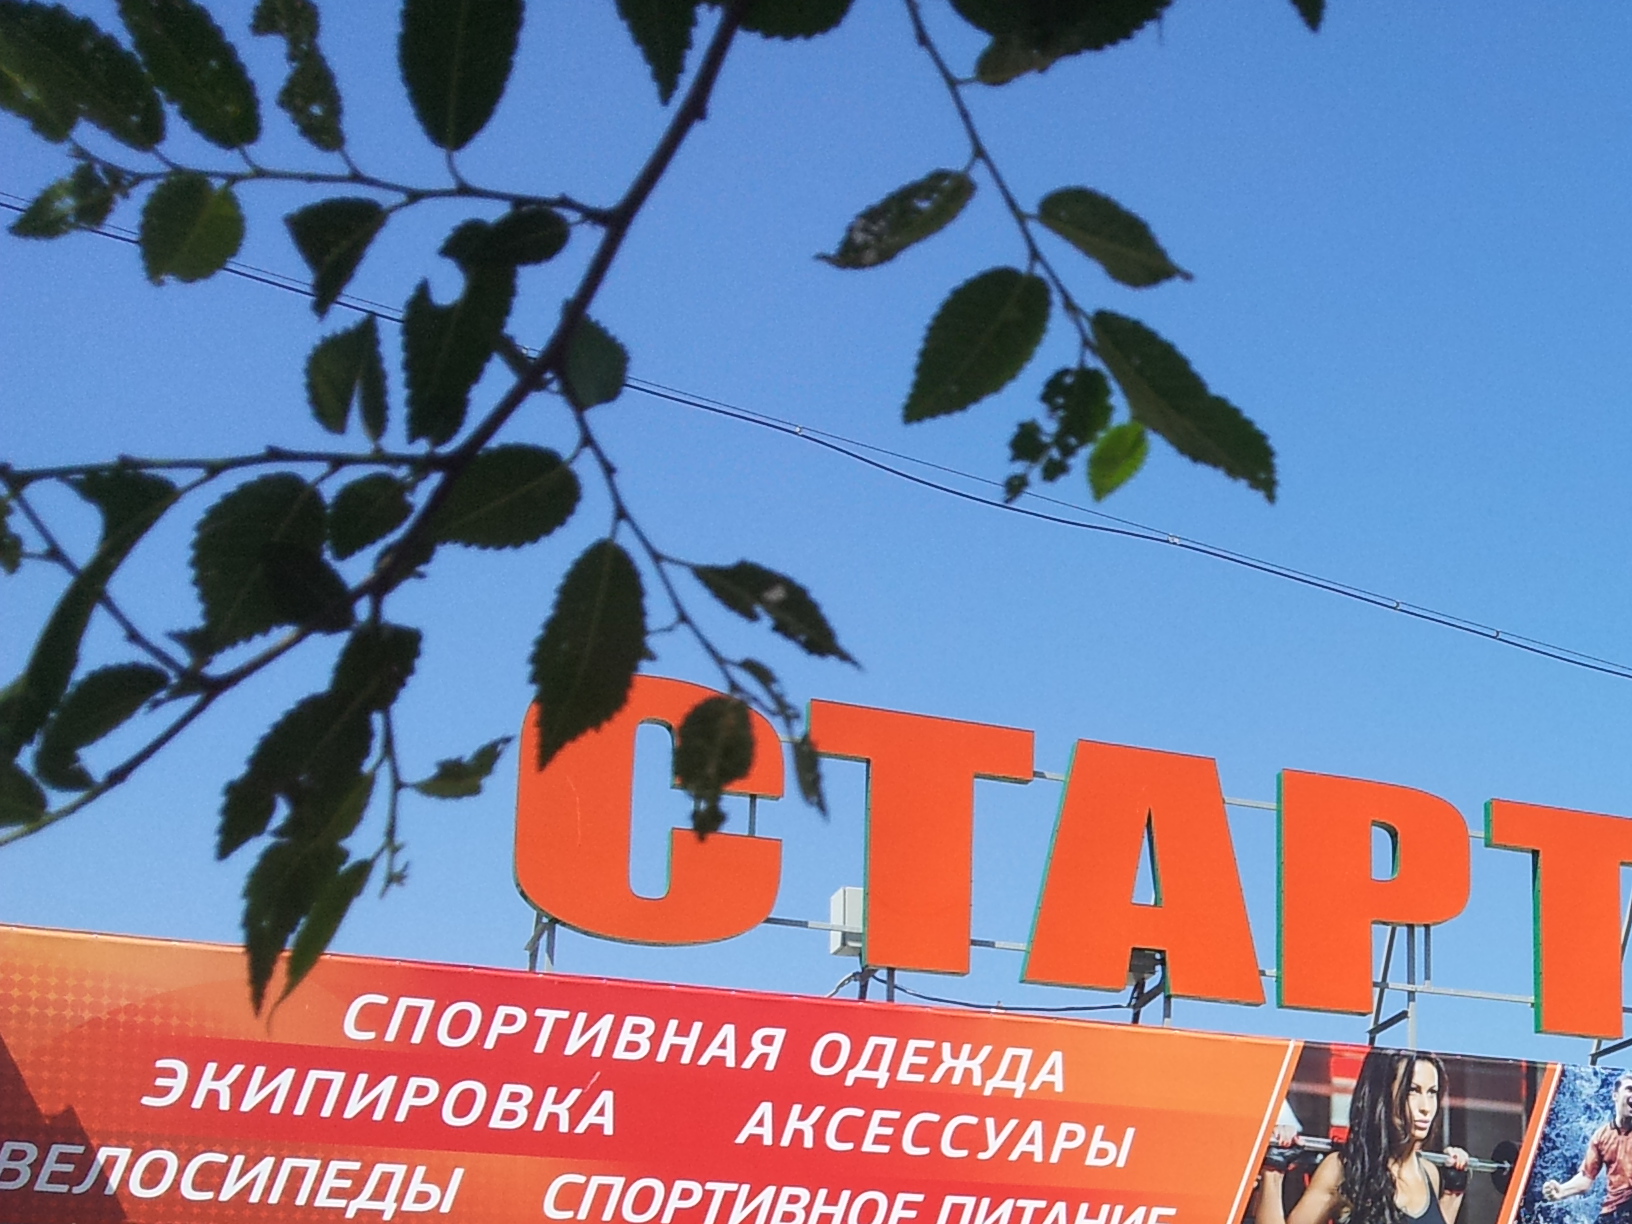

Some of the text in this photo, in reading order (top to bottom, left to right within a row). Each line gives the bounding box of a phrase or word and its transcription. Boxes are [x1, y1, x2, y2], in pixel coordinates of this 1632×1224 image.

[343, 993, 1065, 1098] СПОРТИВНАЯ ОДЕЖДА
[141, 1058, 1136, 1168] ЭКИПИРОВКА АКСЕССУАРЫ
[0, 1141, 465, 1221] ВЕЛОСИПЕДЫ
